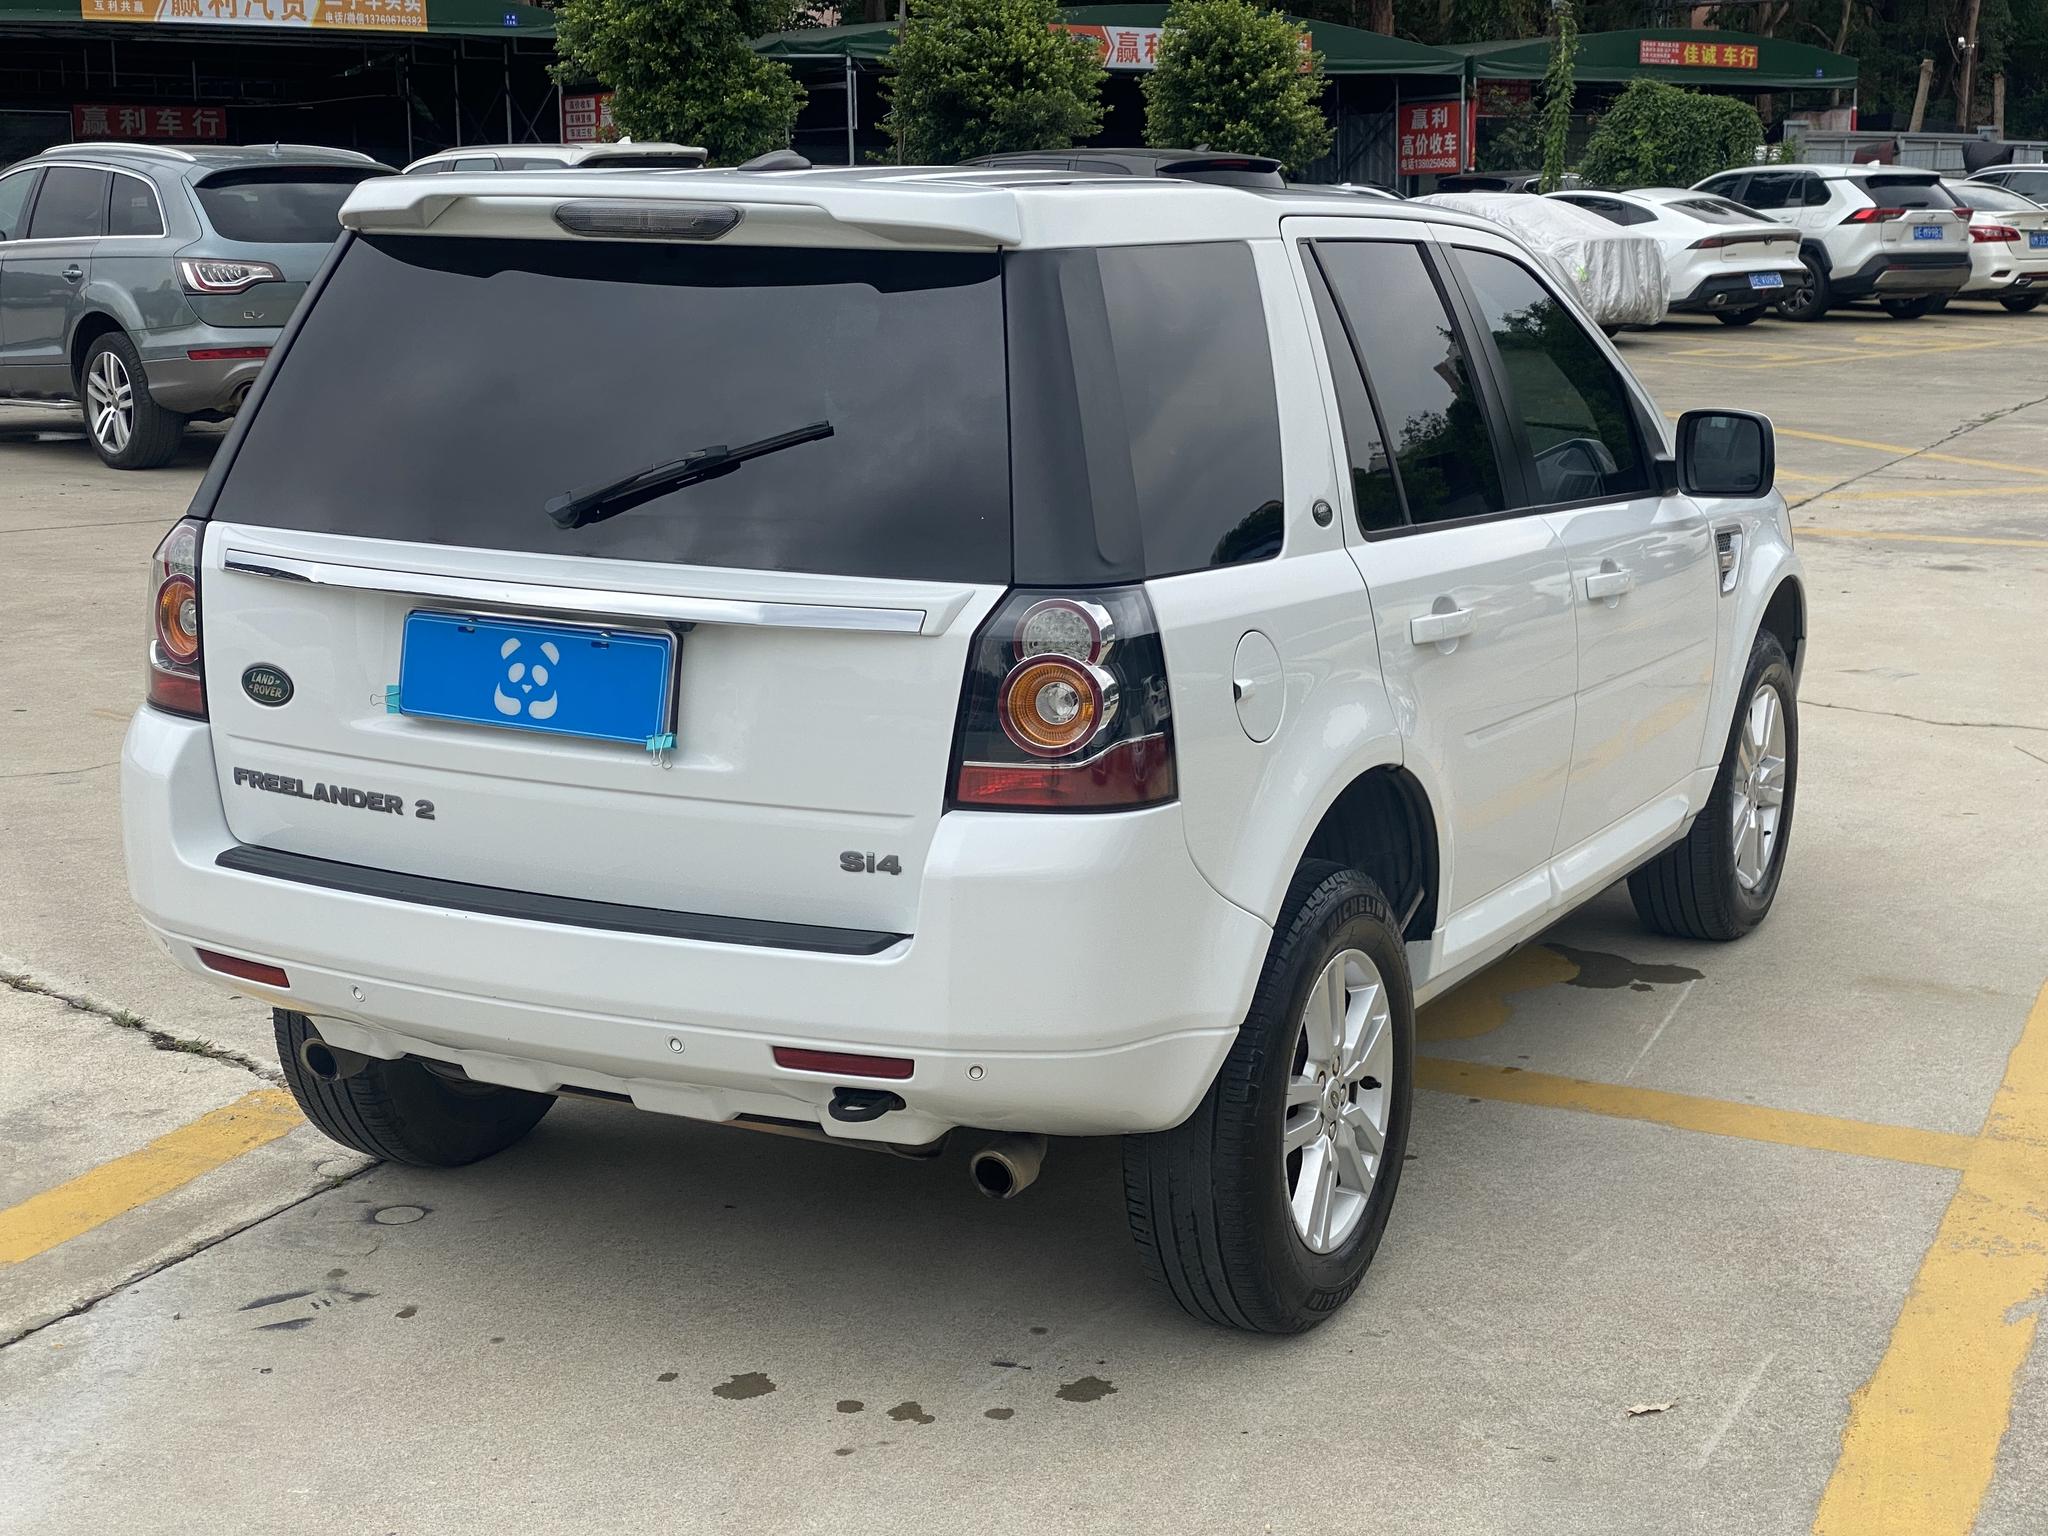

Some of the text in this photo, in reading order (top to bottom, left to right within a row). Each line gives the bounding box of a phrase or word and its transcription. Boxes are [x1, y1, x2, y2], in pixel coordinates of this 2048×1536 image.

[81, 106, 220, 136] 赢利车行
[1411, 106, 1448, 129] 赢利
[1401, 132, 1457, 156] 高价收车
[251, 672, 275, 685] LAND
[253, 683, 282, 698] ROVER
[233, 766, 436, 821] FREELANDER 2
[839, 850, 902, 876] Si4
